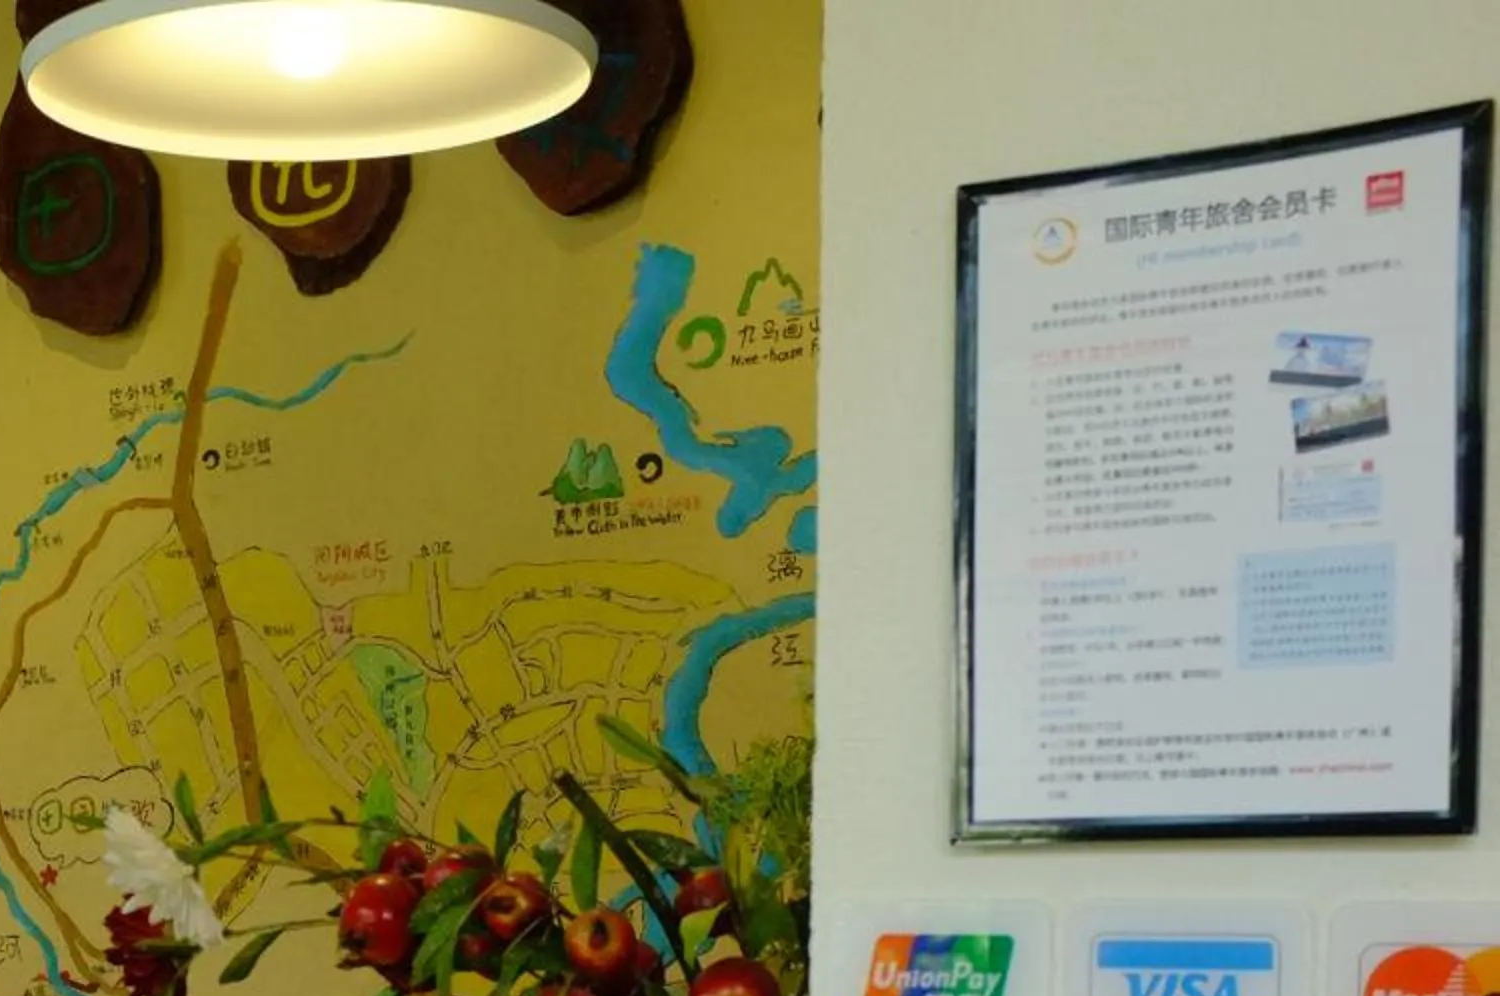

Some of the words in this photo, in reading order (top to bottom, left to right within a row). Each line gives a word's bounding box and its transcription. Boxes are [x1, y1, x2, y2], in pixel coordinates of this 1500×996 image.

[1104, 185, 1338, 244] 国际青年旅舍会员卡
